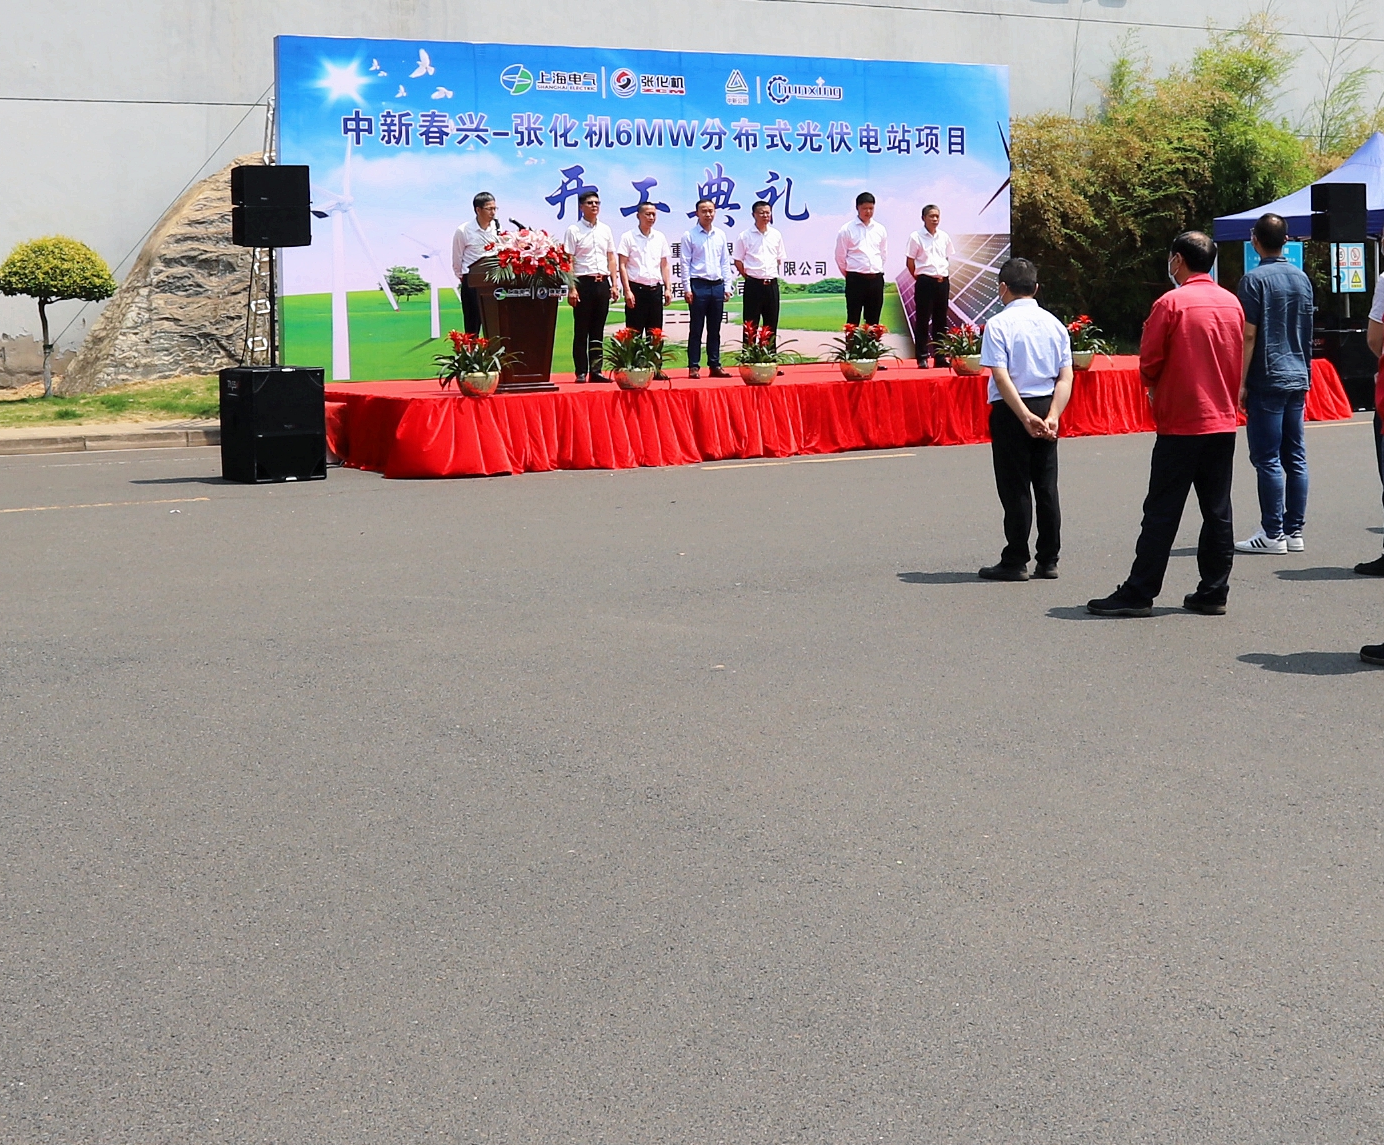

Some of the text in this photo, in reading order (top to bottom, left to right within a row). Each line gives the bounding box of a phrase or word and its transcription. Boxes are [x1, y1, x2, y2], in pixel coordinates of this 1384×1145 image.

[537, 71, 596, 86] 上海电气
[641, 75, 684, 89] 张化机
